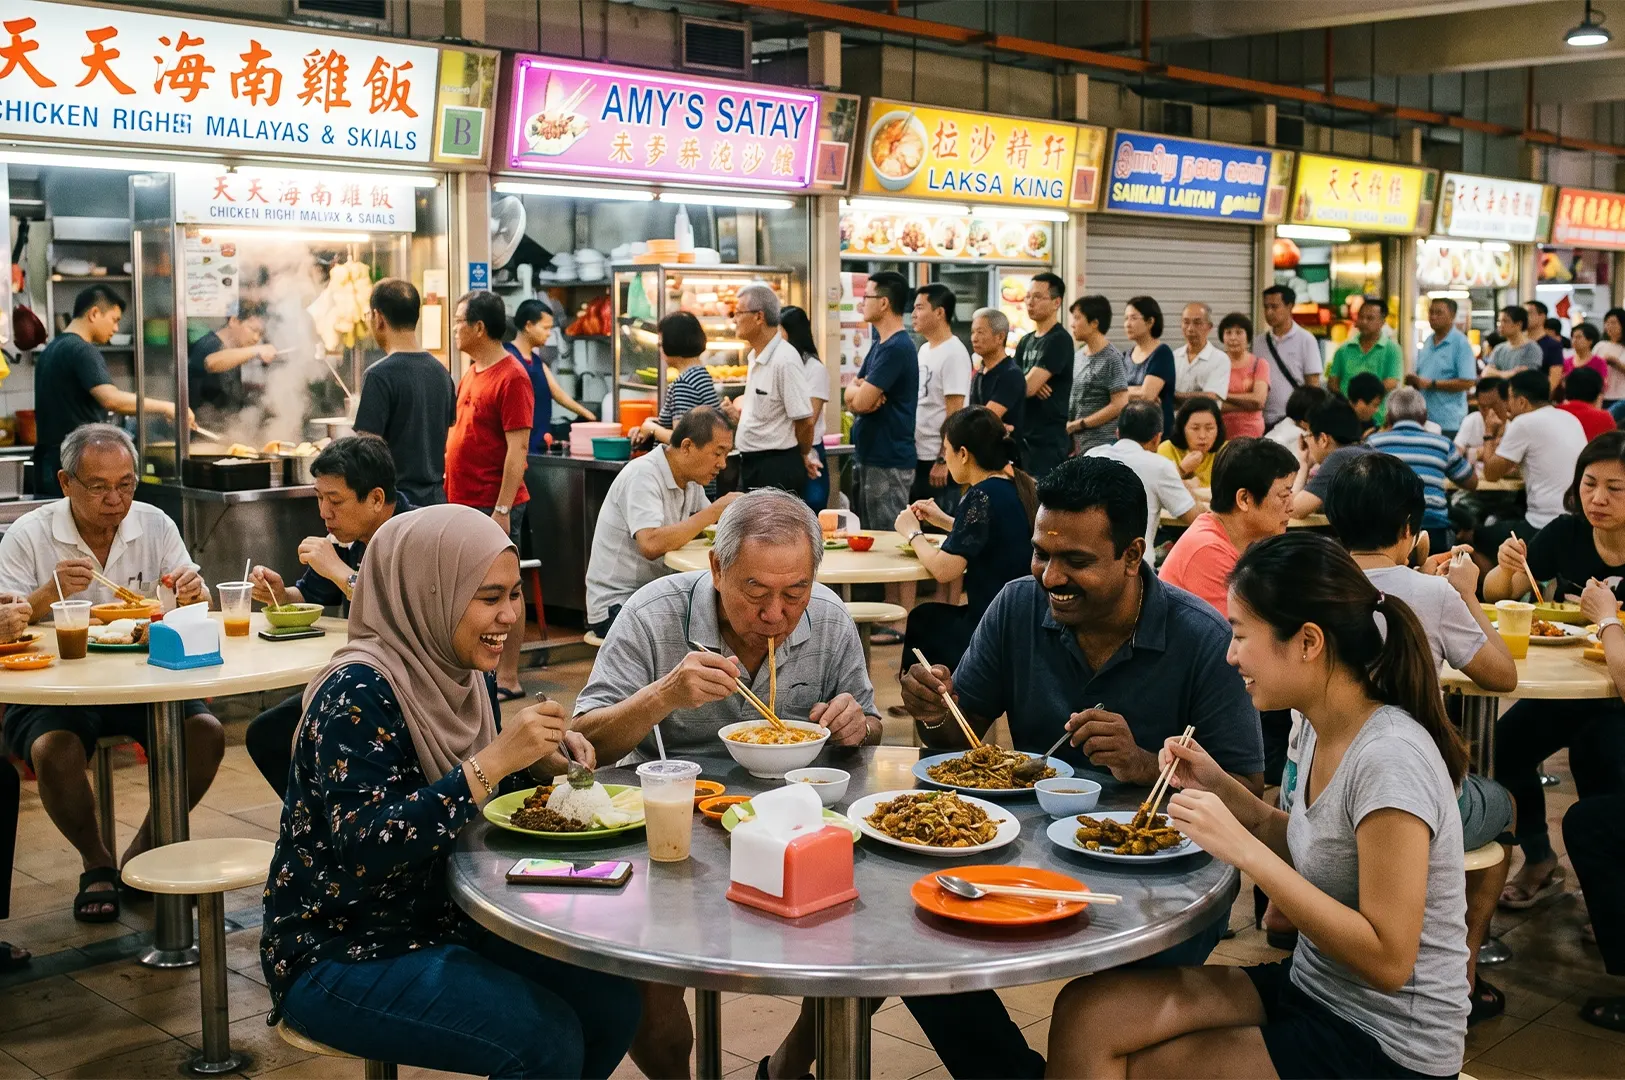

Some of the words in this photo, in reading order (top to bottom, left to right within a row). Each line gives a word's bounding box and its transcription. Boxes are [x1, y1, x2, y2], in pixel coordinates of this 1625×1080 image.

[0, 17, 419, 119] 天天海南雞飯
[0, 99, 98, 128] HICKEN
[206, 116, 309, 143] MALAYAS
[321, 125, 335, 145] &
[347, 126, 417, 151] SKIALS
[453, 117, 471, 146] B
[601, 85, 704, 130] AMY'S
[716, 97, 808, 139] SATAY
[929, 169, 1003, 195] LAKSA
[1013, 177, 1064, 199] KING
[210, 205, 260, 219] CHICKEN
[346, 212, 353, 223] &
